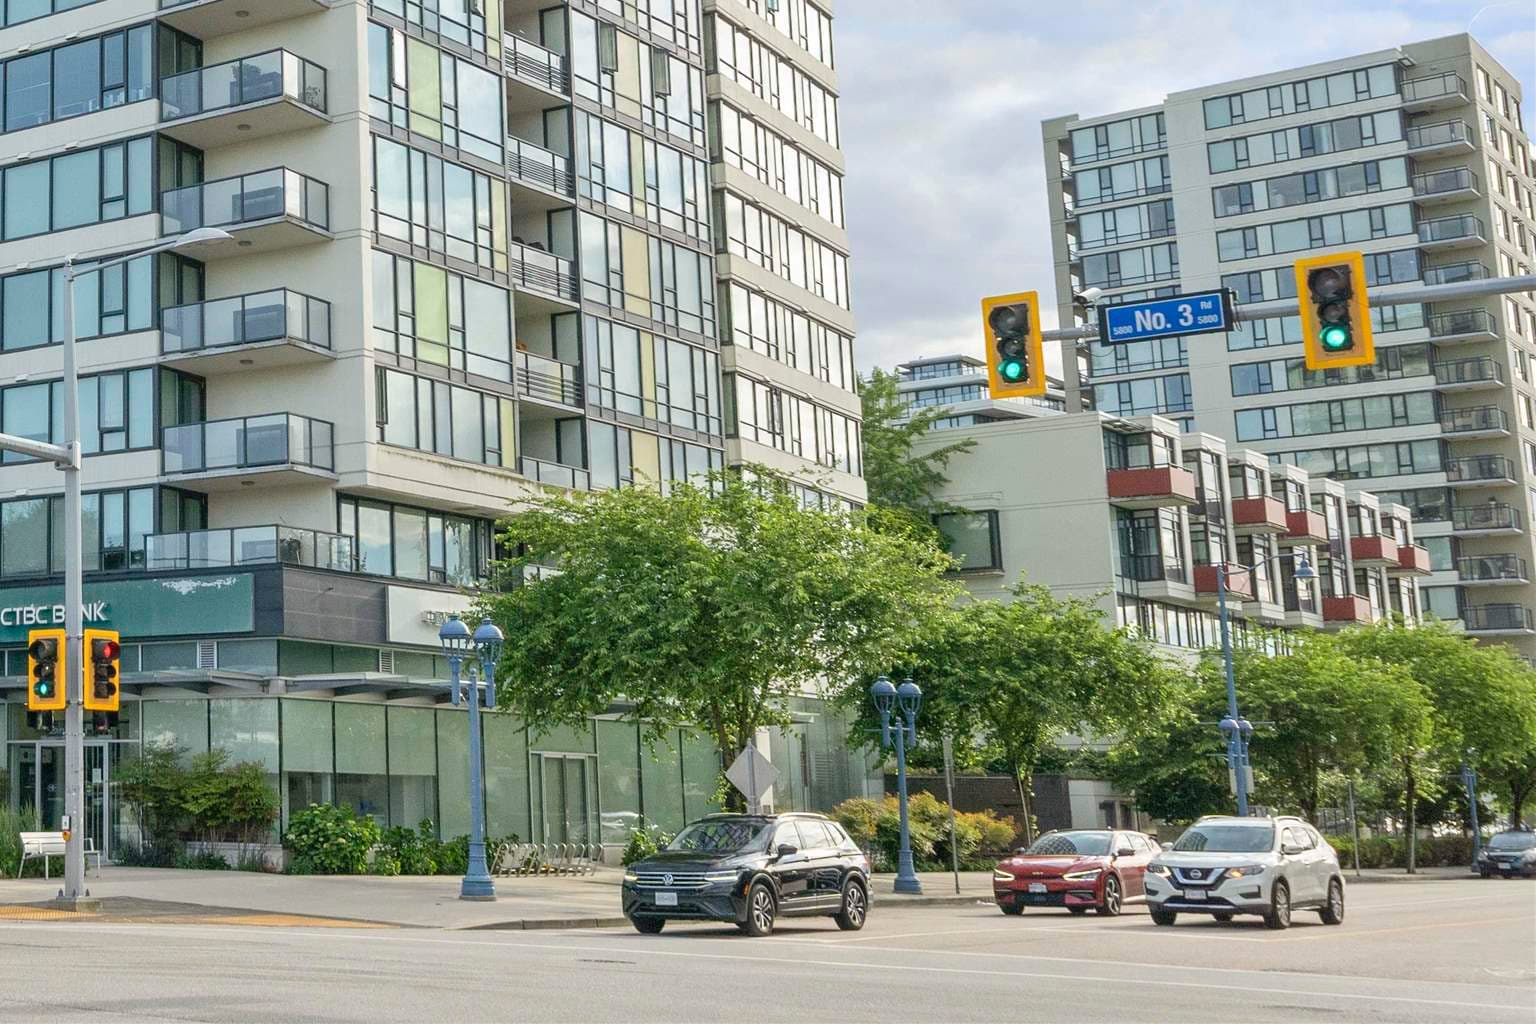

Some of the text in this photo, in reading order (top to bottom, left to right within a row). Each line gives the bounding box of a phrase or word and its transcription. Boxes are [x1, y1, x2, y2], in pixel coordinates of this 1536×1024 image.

[1134, 301, 1212, 332] No. 3 Rd
[1, 601, 107, 626] CTBC BNK
